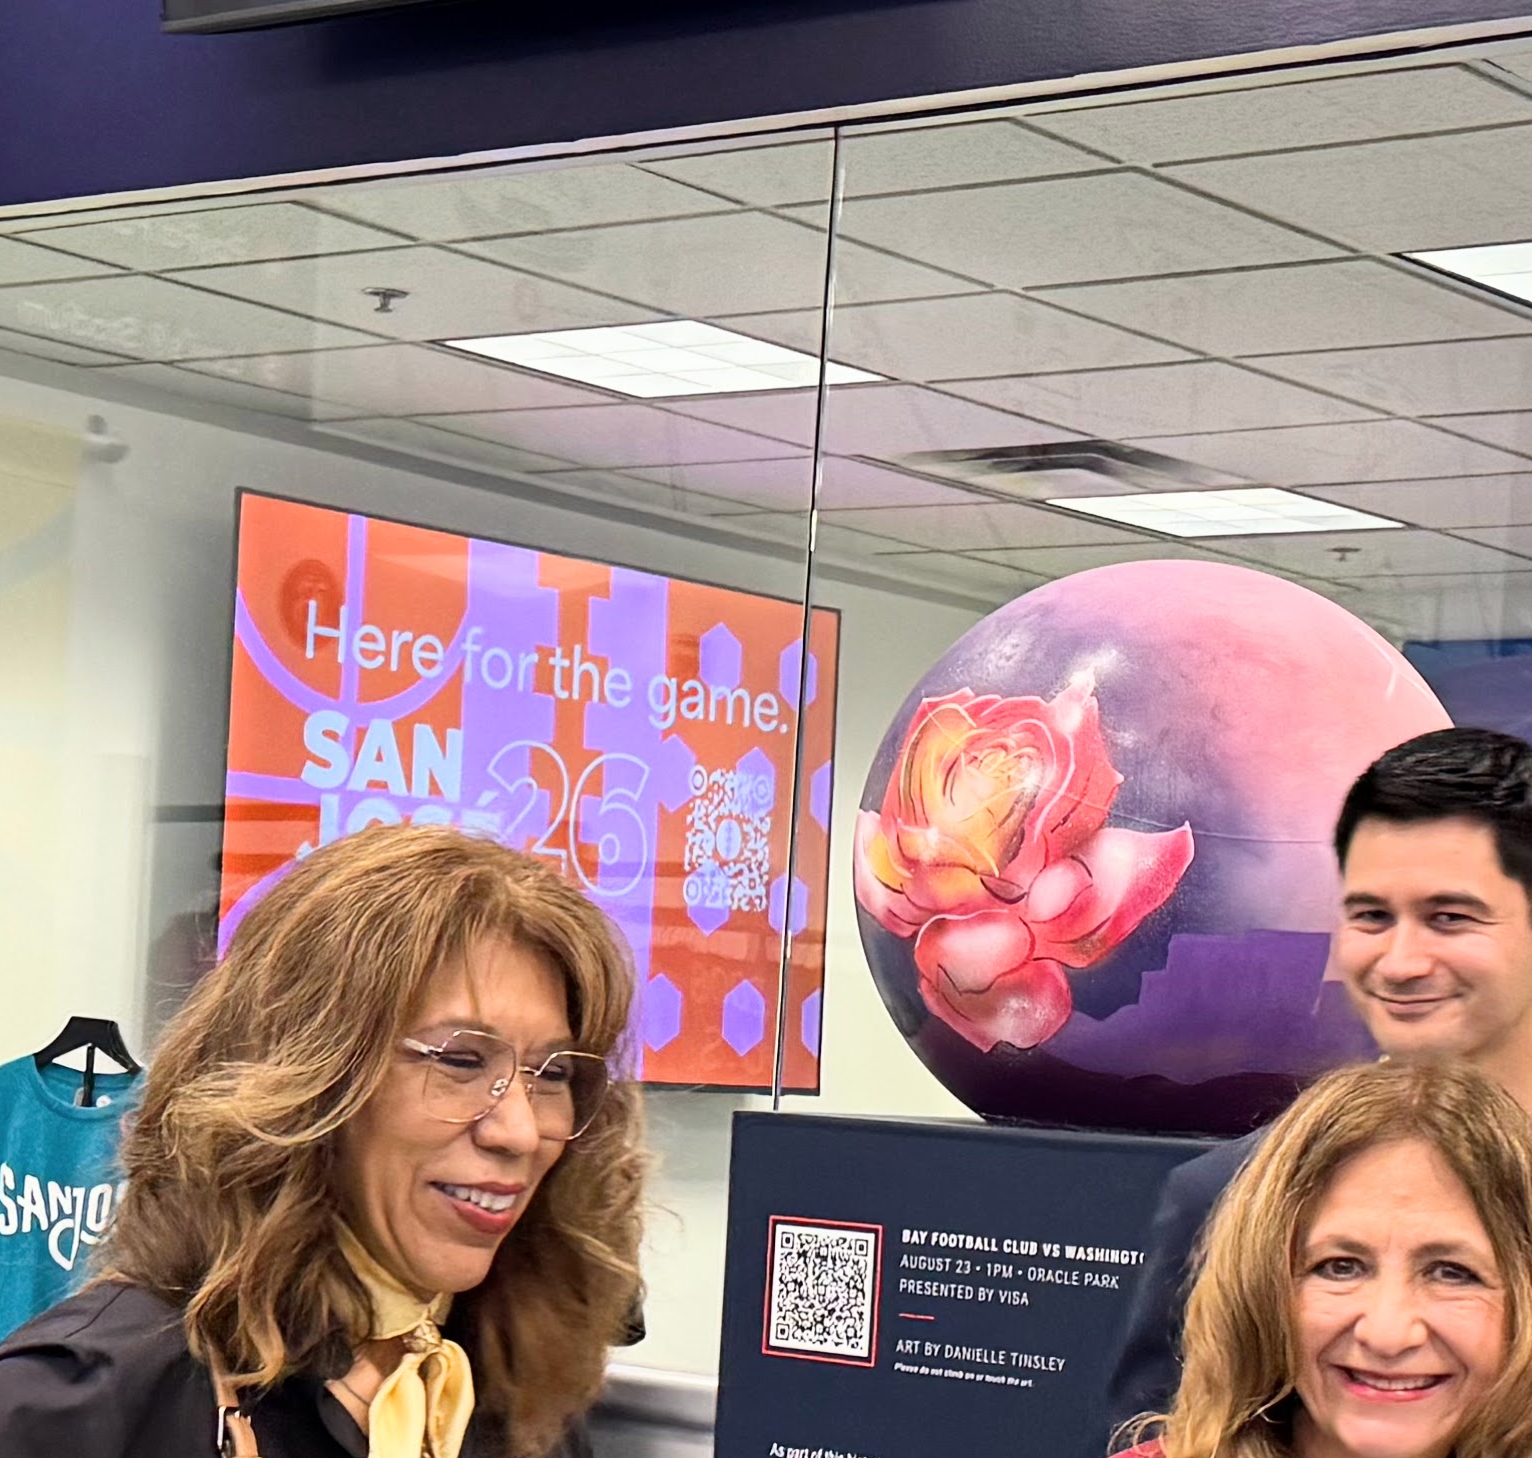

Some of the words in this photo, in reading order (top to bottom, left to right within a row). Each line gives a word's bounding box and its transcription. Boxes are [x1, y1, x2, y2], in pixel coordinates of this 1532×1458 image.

[305, 599, 445, 680] Here
[460, 625, 537, 691] for
[549, 642, 632, 708] the
[647, 671, 789, 735] game.
[301, 710, 462, 802] SAN
[901, 1228, 929, 1246] BAY
[930, 1231, 998, 1253] FOOTBALL
[1002, 1238, 1038, 1257] CLUB
[1042, 1243, 1061, 1258] VS
[900, 1253, 951, 1273] AUGUST
[955, 1259, 972, 1275] 23
[986, 1262, 1014, 1279] 1PM
[1027, 1266, 1080, 1287] ORACLE
[1084, 1272, 1120, 1290] PARK
[899, 1278, 975, 1301] PRESENTED
[977, 1287, 995, 1303] BY
[998, 1290, 1030, 1307] VISA
[896, 1338, 921, 1356] ART
[924, 1341, 942, 1358] BY
[944, 1344, 1006, 1366] DANIELLE
[1010, 1352, 1066, 1373] TINSLEY
